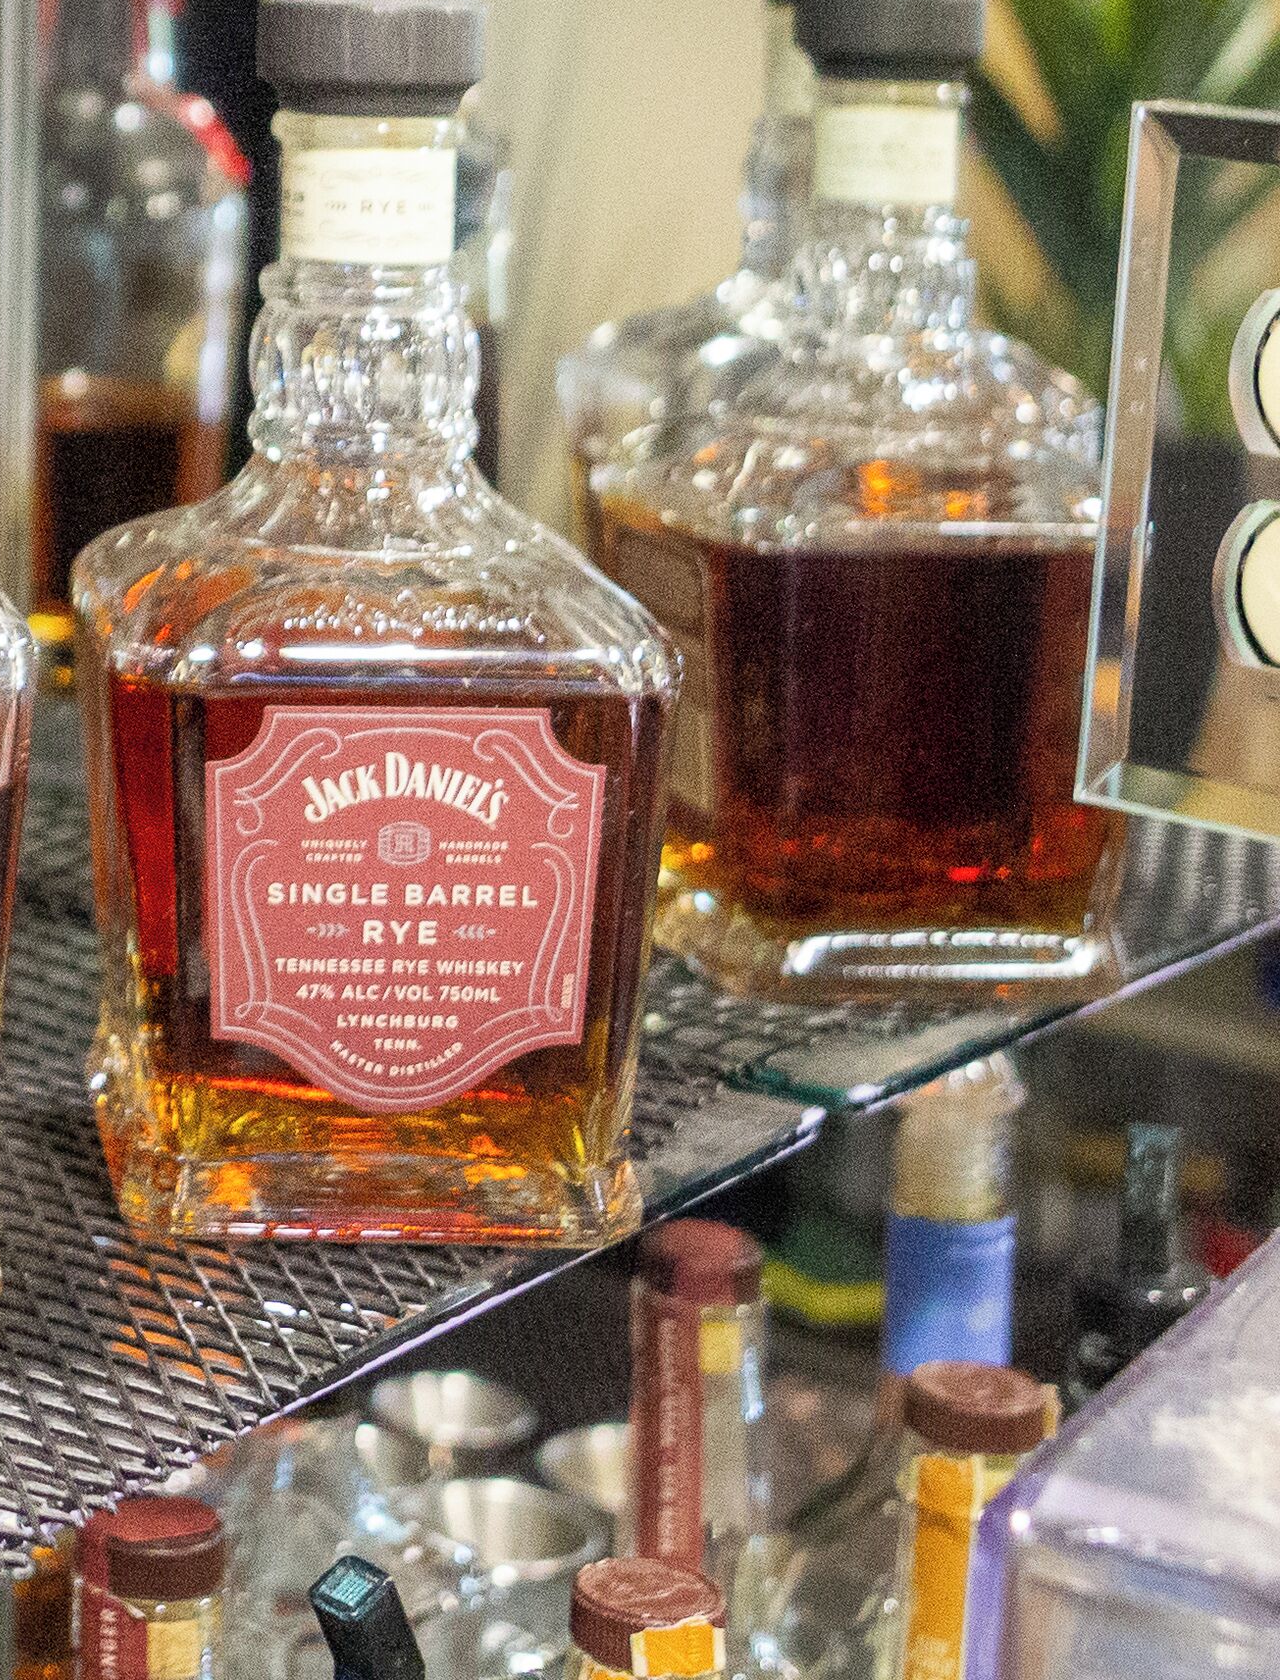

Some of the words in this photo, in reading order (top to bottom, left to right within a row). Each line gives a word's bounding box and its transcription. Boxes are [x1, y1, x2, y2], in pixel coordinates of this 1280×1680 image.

[359, 199, 407, 215] RYE
[301, 762, 382, 824] JACK
[385, 751, 510, 826] DANIEL'S
[300, 838, 368, 849] UNIQUELY
[439, 840, 510, 851] HANDMADE
[305, 852, 363, 863] CRAFTED
[445, 854, 502, 864] BARRELS
[266, 882, 389, 907] SINGLE
[404, 883, 538, 908] BARREL
[362, 920, 439, 946] RYE
[274, 957, 386, 974] TENNESSEE
[392, 958, 429, 975] RYE
[436, 959, 525, 976] WHISKEY
[295, 984, 335, 1000] 47%
[439, 984, 501, 1002] 750ML
[336, 1013, 460, 1029] LYNCHBURG
[373, 1037, 421, 1051] TENN.
[329, 1039, 384, 1075] MASTER
[389, 1041, 464, 1077] DISTILLED
